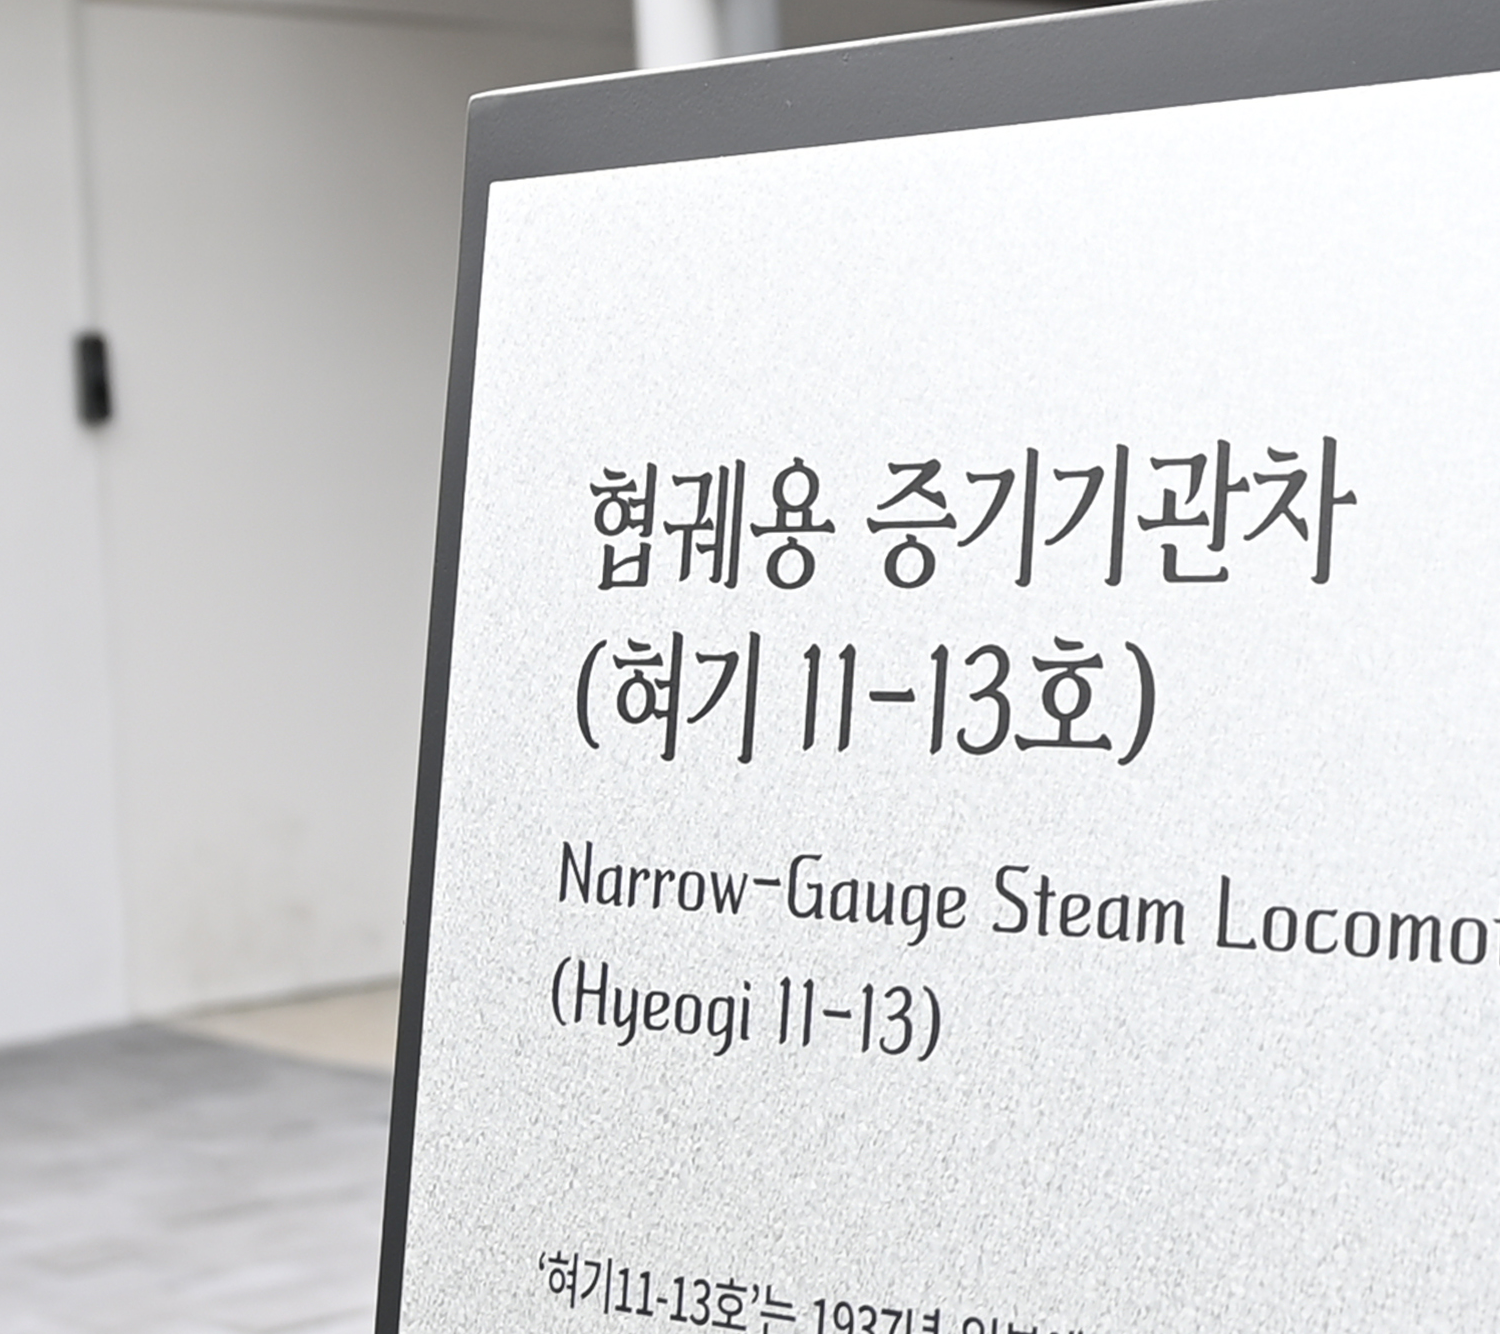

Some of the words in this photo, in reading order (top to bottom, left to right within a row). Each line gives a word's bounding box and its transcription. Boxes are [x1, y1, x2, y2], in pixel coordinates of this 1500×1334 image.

[588, 455, 837, 592] 협궤용
[865, 434, 1359, 591] 증기기관차
[575, 629, 762, 766] (혀기
[801, 635, 1157, 767] 11-13호)
[557, 840, 968, 948] Narrow-Gauge
[991, 863, 1186, 947] Steam
[550, 955, 753, 1058] (Hyeogi
[777, 975, 943, 1063] 11-13)
